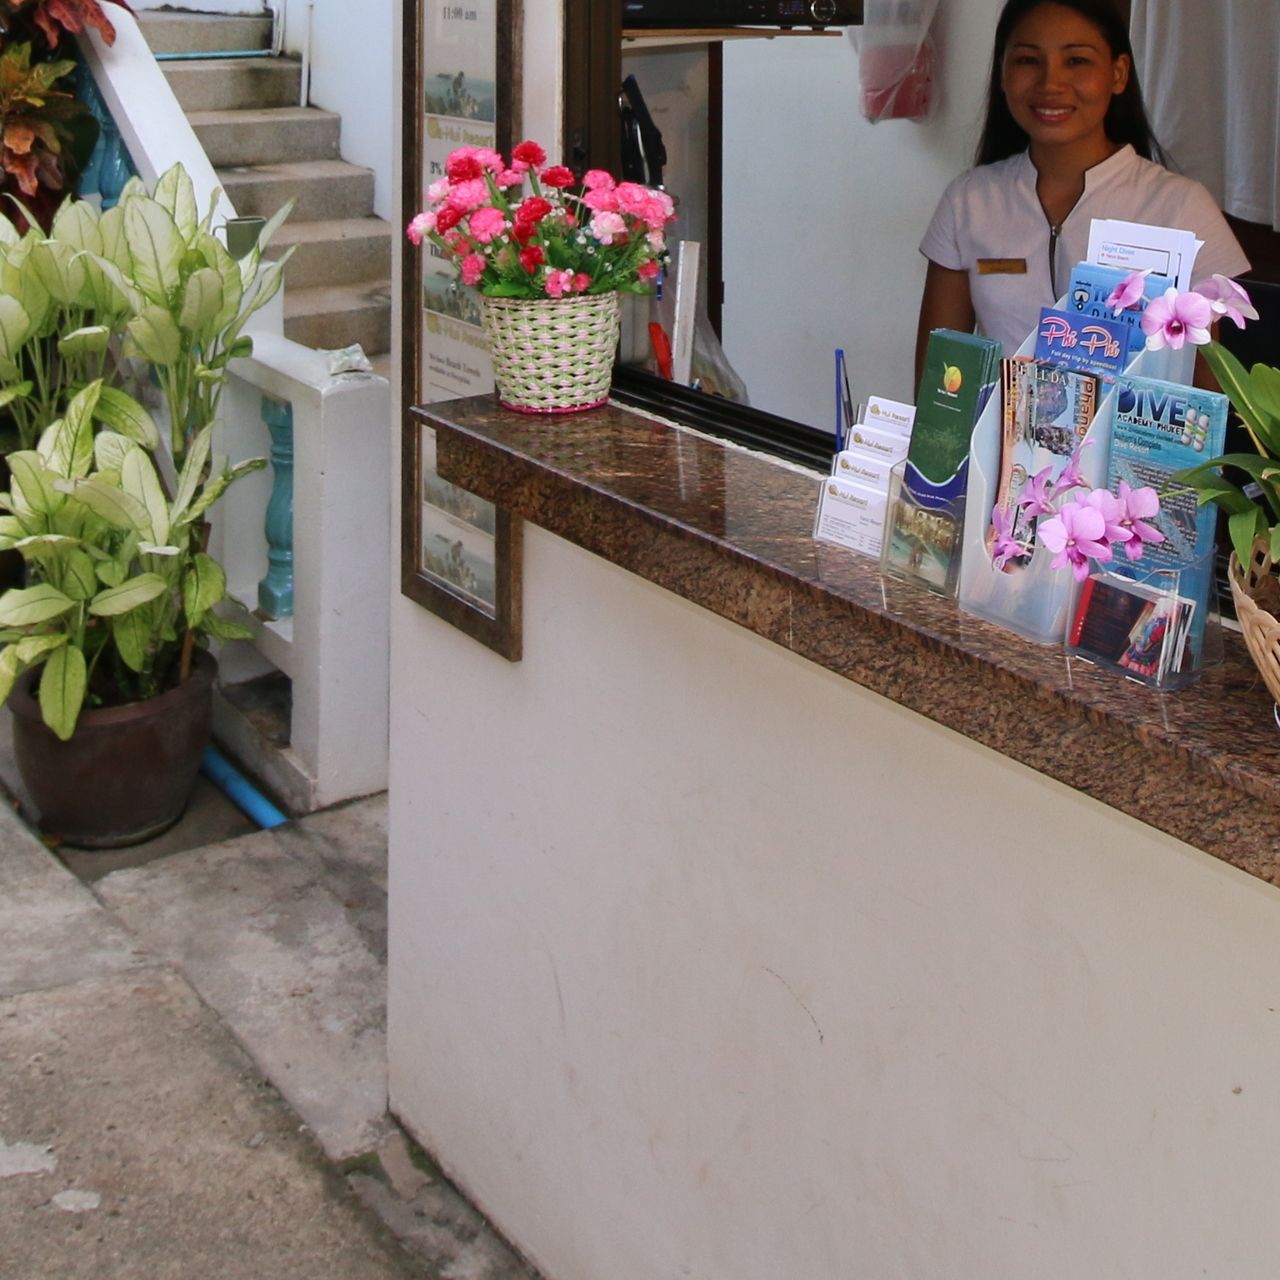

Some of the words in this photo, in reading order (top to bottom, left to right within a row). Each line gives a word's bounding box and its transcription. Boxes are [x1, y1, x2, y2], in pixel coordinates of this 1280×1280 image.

[1040, 316, 1078, 348] Phi
[1080, 325, 1121, 359] Phi
[1117, 385, 1188, 428] DIVE
[1117, 413, 1154, 431] ACADEMY
[1157, 423, 1186, 436] PHUKET
